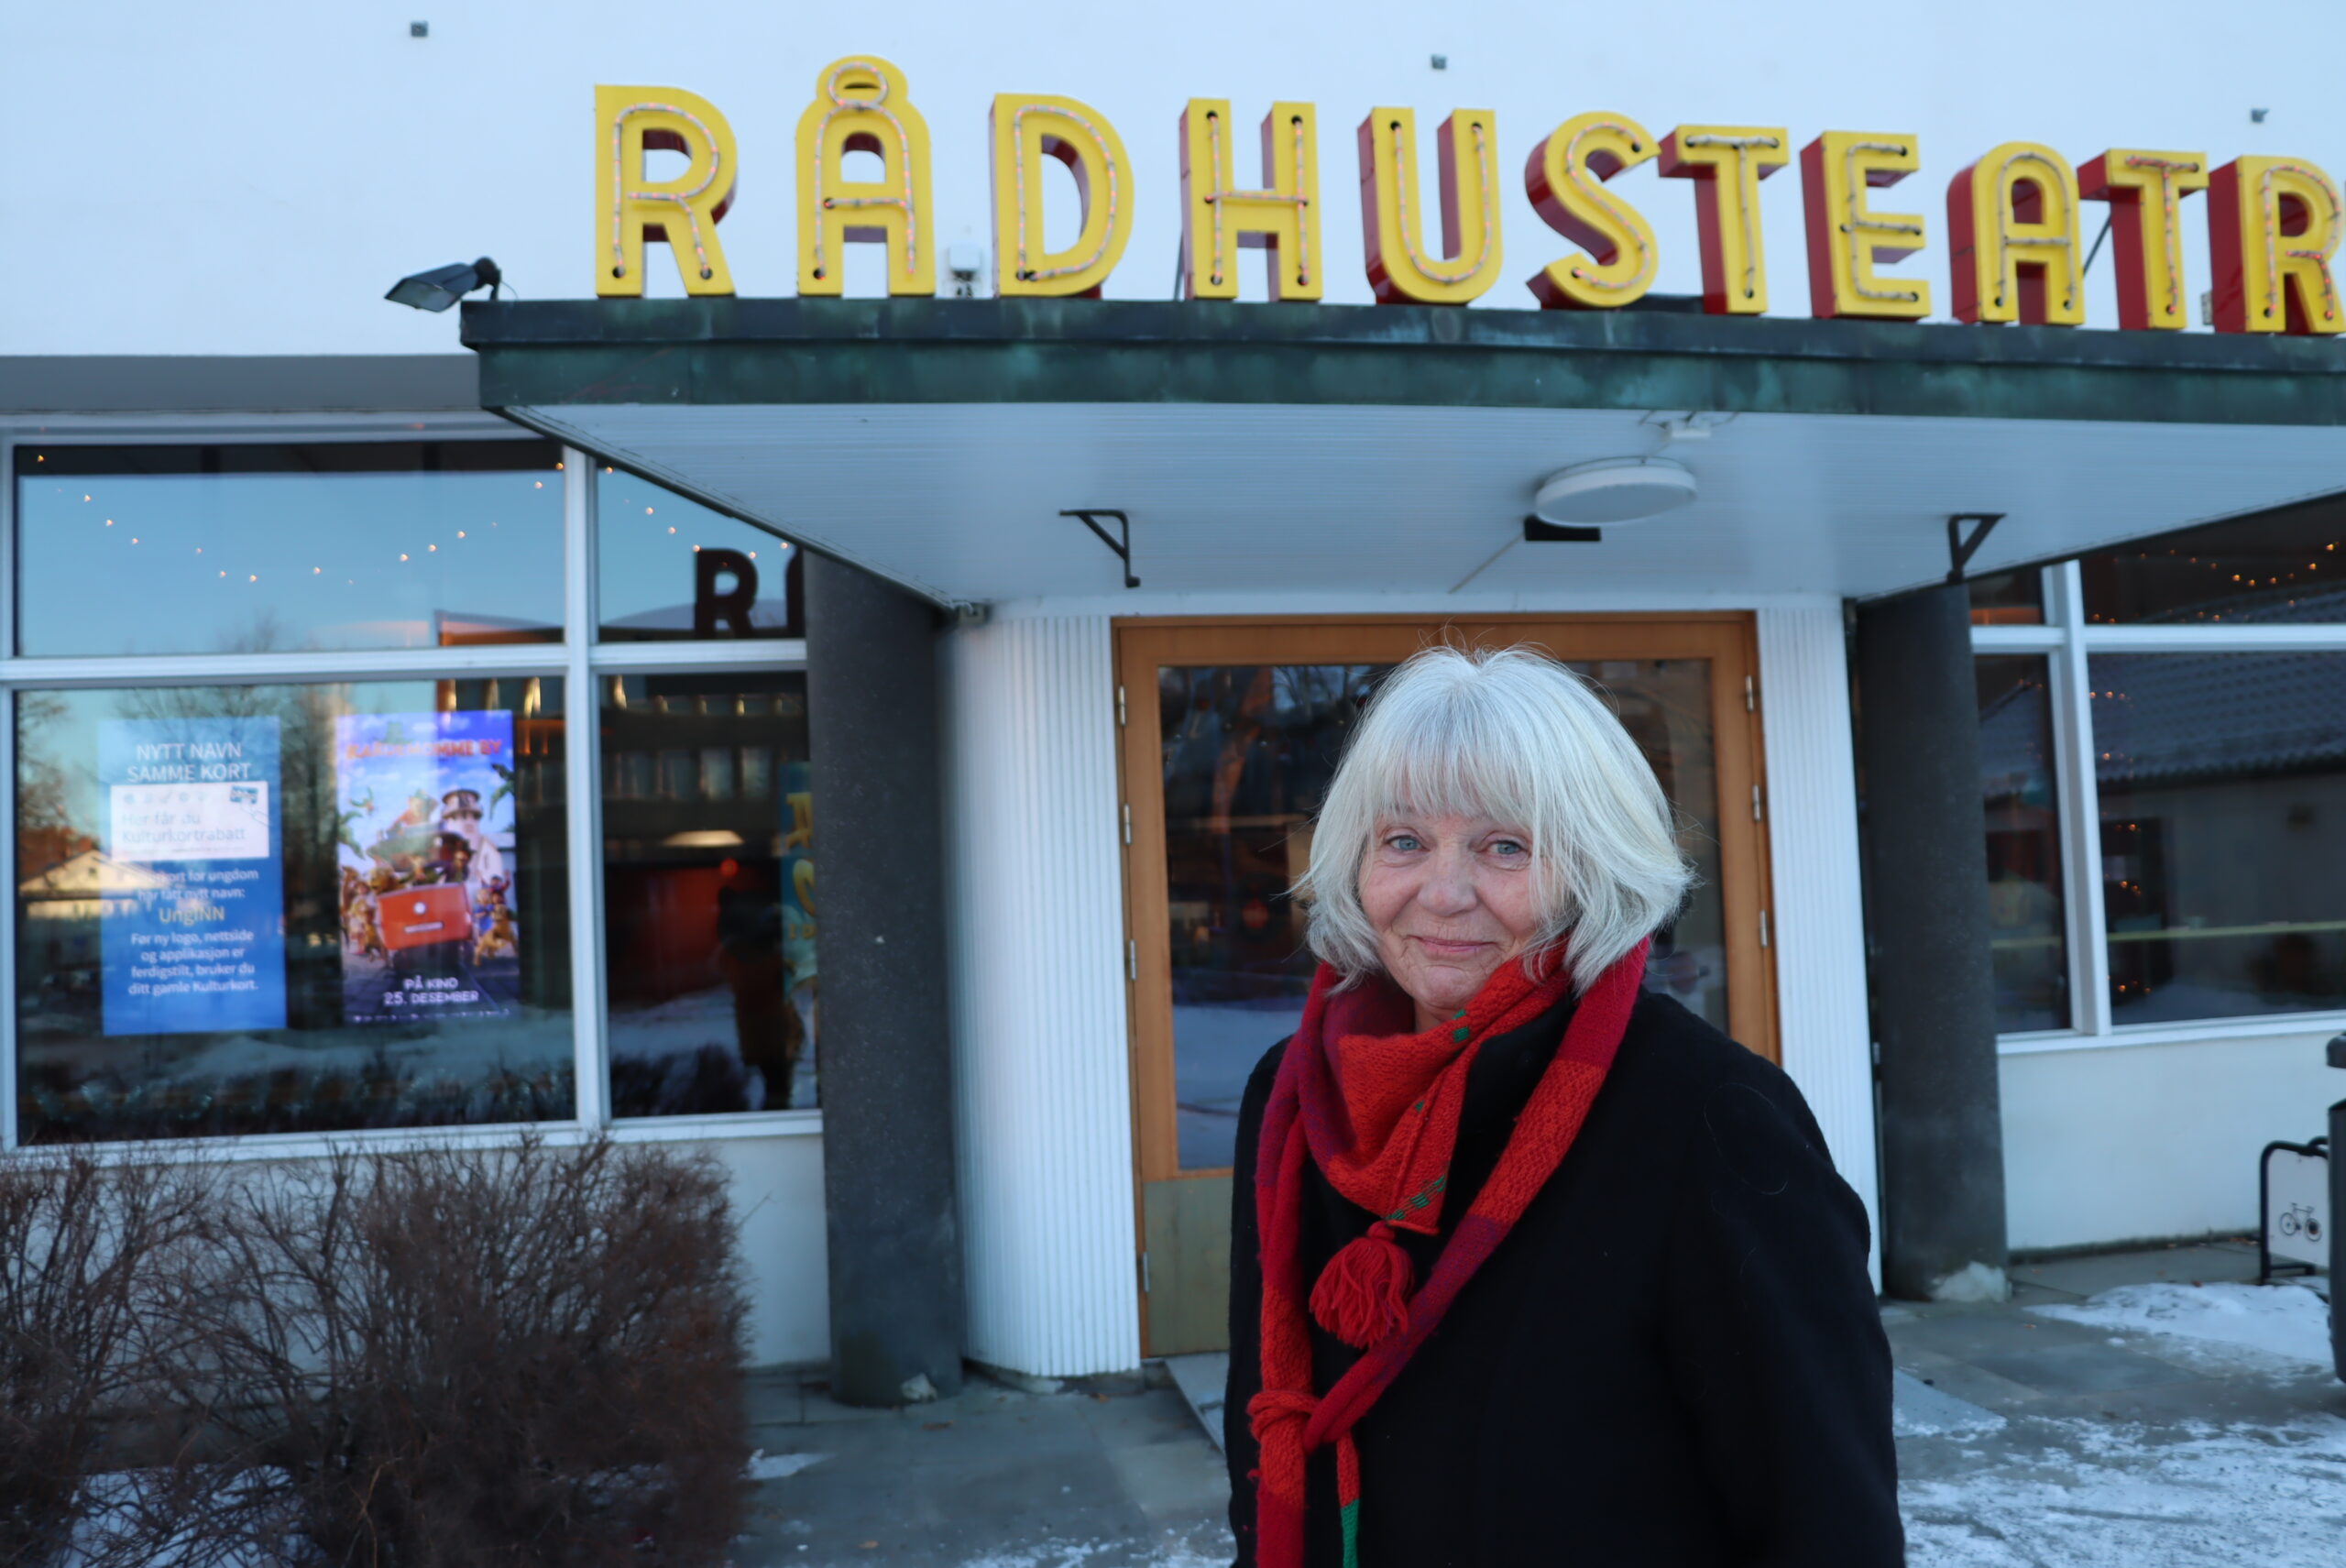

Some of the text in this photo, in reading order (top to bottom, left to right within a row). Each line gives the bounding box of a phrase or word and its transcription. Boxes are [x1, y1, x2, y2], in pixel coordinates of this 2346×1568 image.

[594, 55, 2346, 335] RÅDHUSTEATR
[137, 741, 242, 761] NYTT NAVN
[126, 762, 251, 783] SAMME KORT
[208, 868, 259, 884] ungdom
[204, 929, 255, 943] nettside
[159, 948, 229, 963] applikasjon
[195, 963, 236, 975] bruker
[237, 961, 255, 974] du
[127, 982, 151, 995] ditt
[153, 982, 191, 997] gamle
[403, 975, 459, 990] PÅ KINO
[411, 990, 479, 1003] DESEMBER
